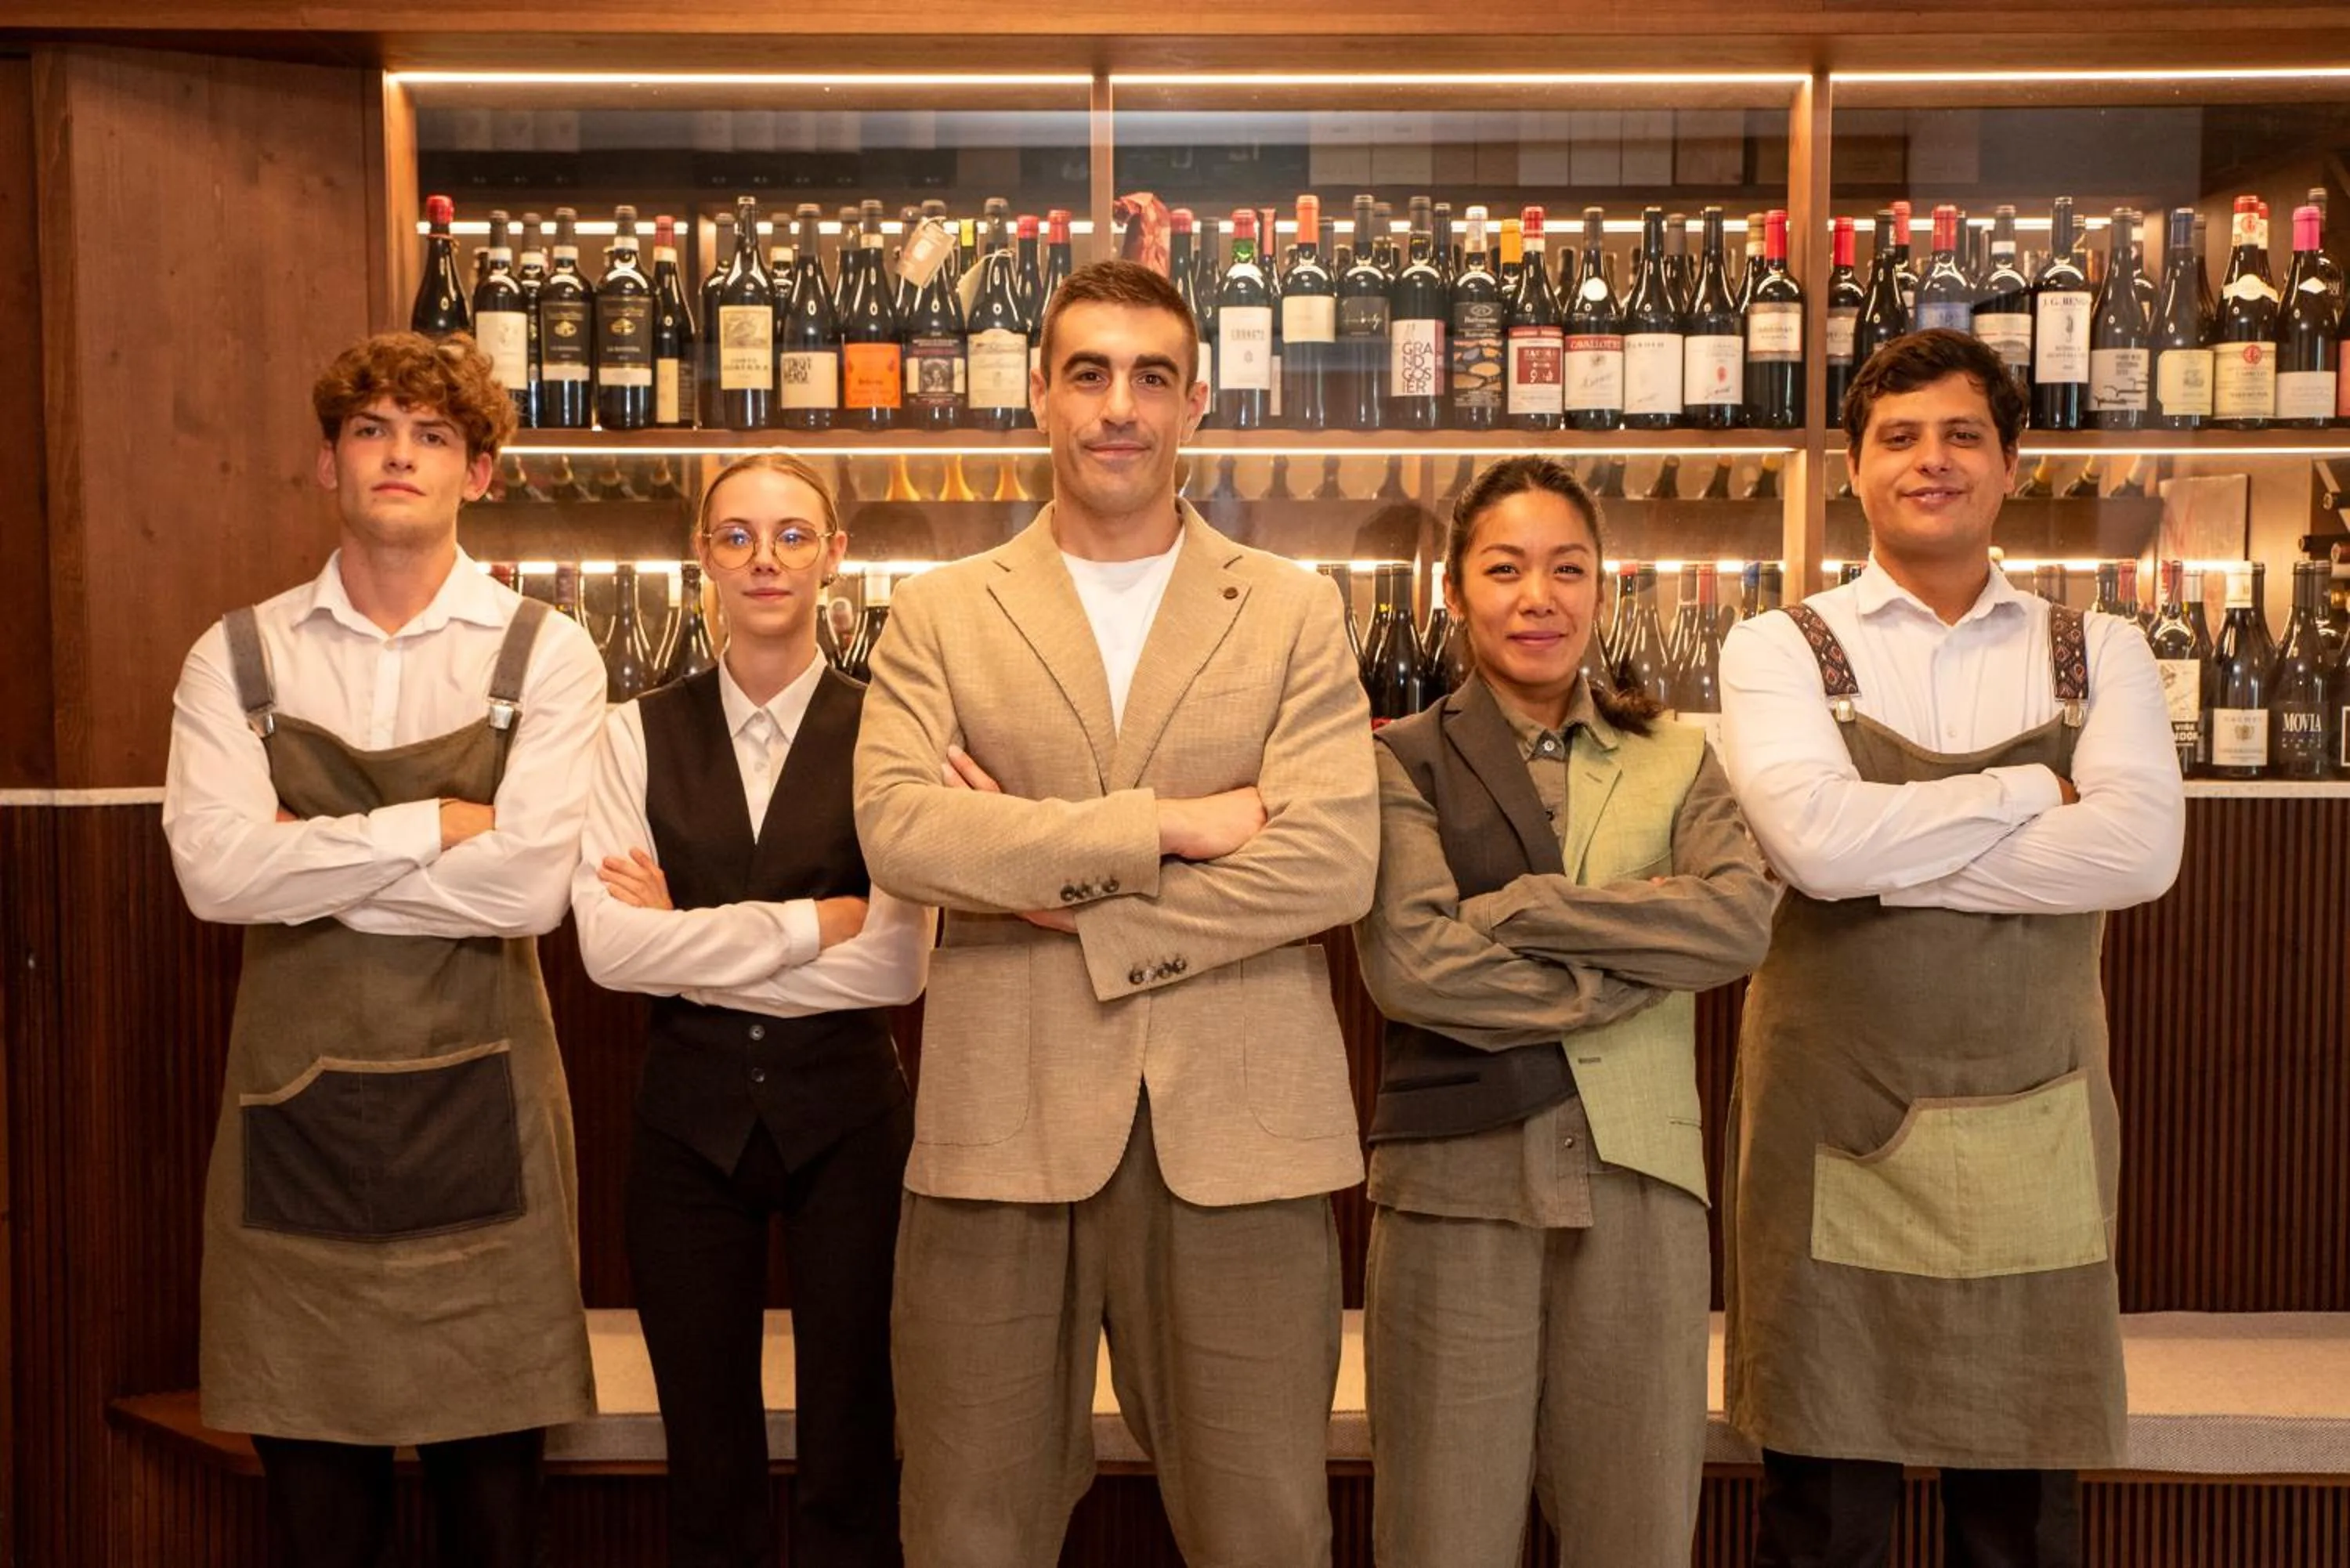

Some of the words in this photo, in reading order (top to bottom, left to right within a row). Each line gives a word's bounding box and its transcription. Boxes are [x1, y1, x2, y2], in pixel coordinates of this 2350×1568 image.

[1402, 341, 1433, 355] GRA
[1402, 367, 1433, 381] GOS
[2283, 713, 2322, 732] MOVIA
